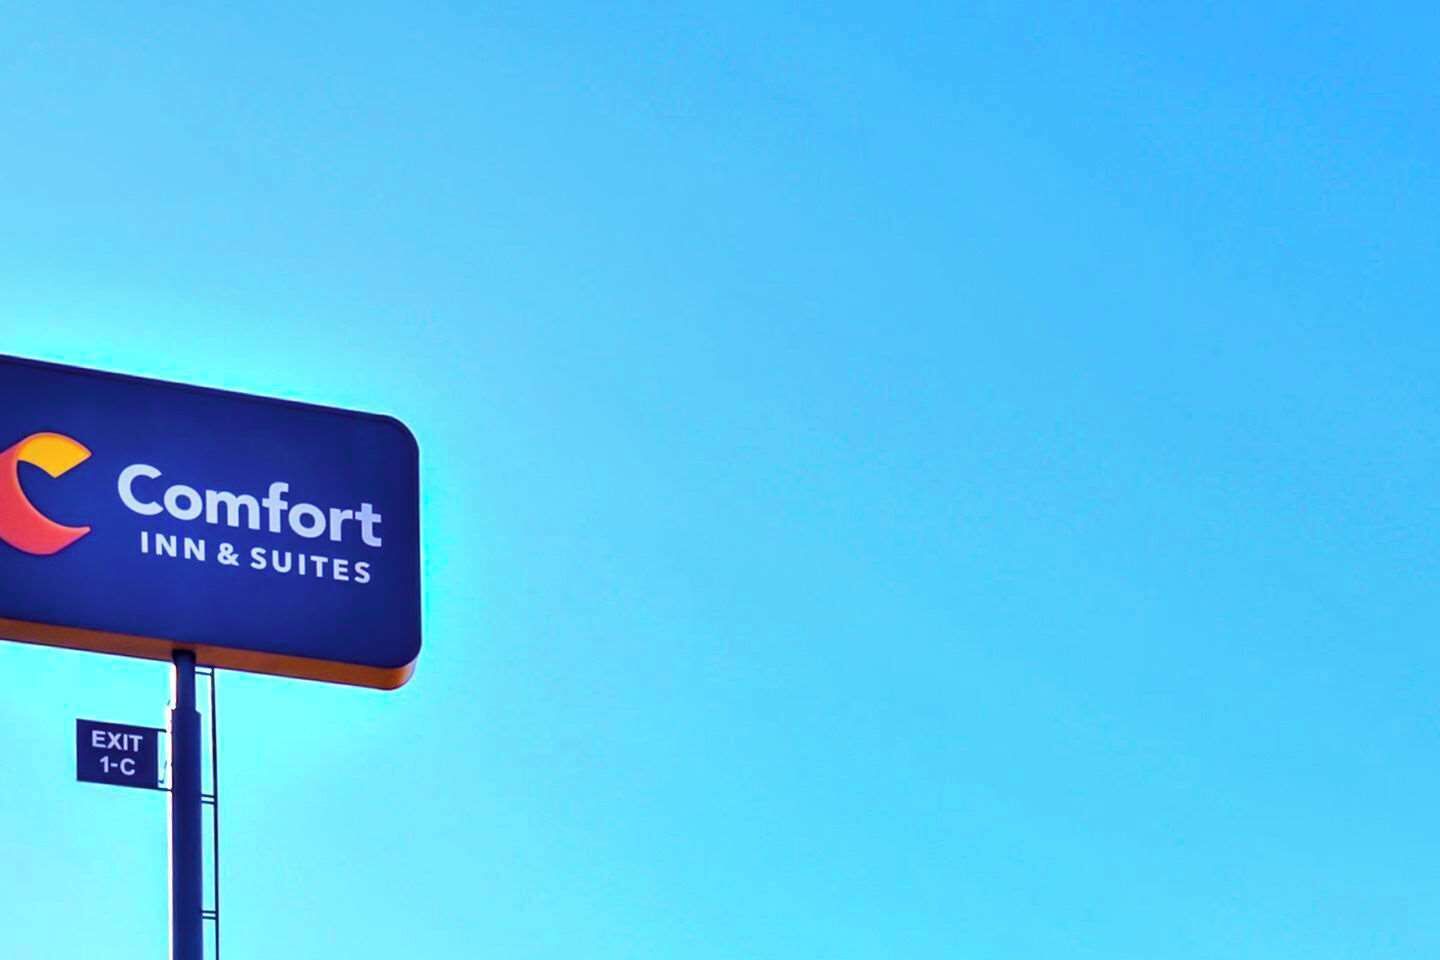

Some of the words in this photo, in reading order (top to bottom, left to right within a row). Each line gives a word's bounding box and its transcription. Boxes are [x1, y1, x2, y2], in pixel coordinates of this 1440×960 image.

[117, 463, 383, 548] Comfort
[140, 531, 206, 561] INN
[216, 543, 240, 567] &
[250, 546, 371, 584] SUITES
[91, 729, 144, 752] EXIT
[99, 755, 136, 776] 1-C
